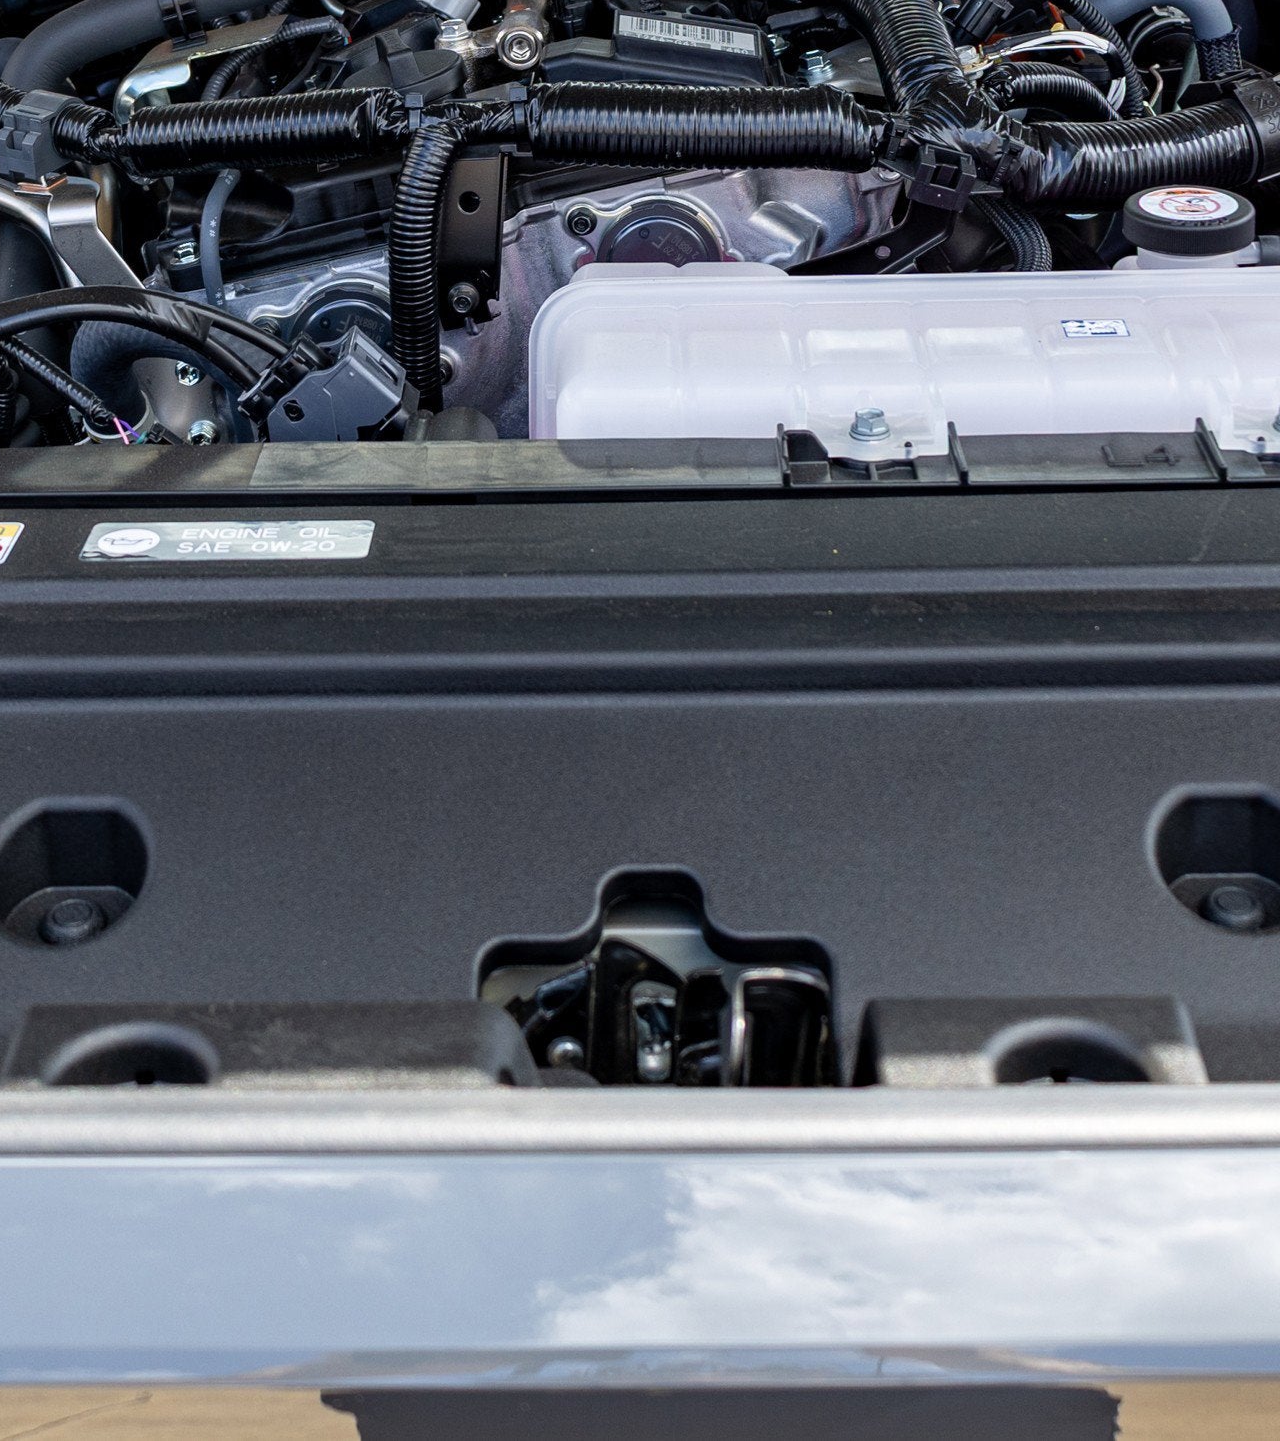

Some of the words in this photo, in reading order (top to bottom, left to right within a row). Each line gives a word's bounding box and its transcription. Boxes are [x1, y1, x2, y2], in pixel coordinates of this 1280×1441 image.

[181, 527, 280, 540] ENGINE
[298, 527, 339, 539] OIL
[176, 541, 230, 554] SAE
[250, 540, 336, 553] 0W-20
